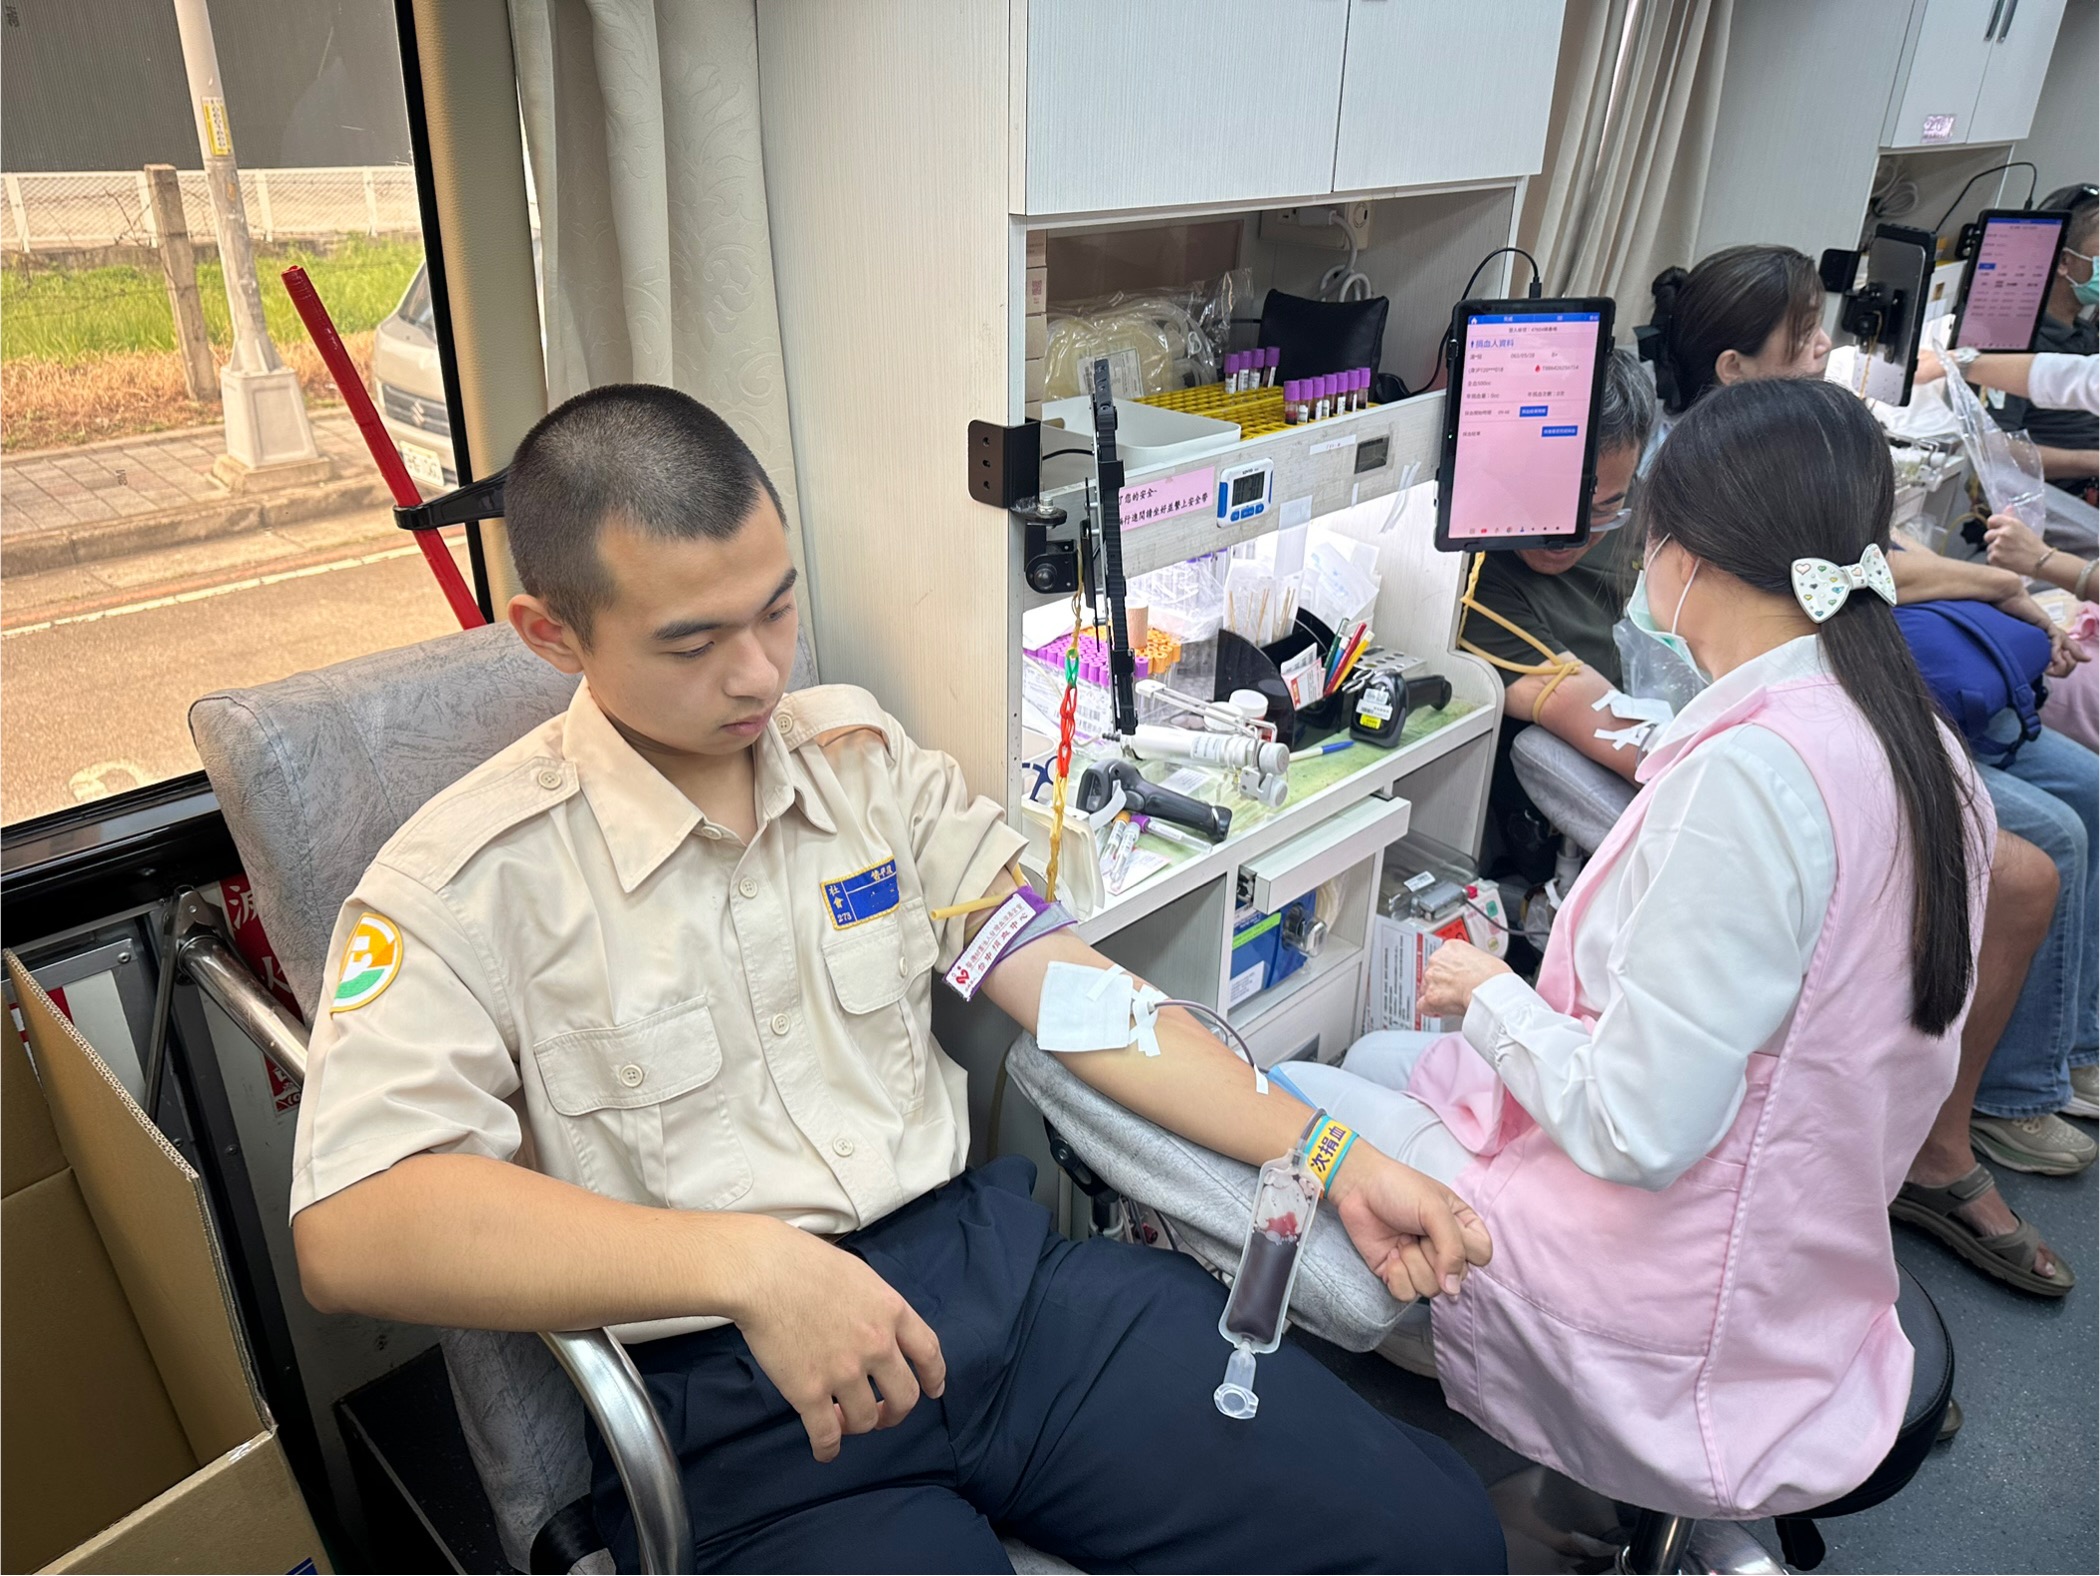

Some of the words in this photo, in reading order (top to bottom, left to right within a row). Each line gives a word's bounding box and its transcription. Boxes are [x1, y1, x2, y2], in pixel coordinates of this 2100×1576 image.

[978, 912, 1028, 972] 台中捐血中心
[1310, 1126, 1346, 1173] 次捐血
